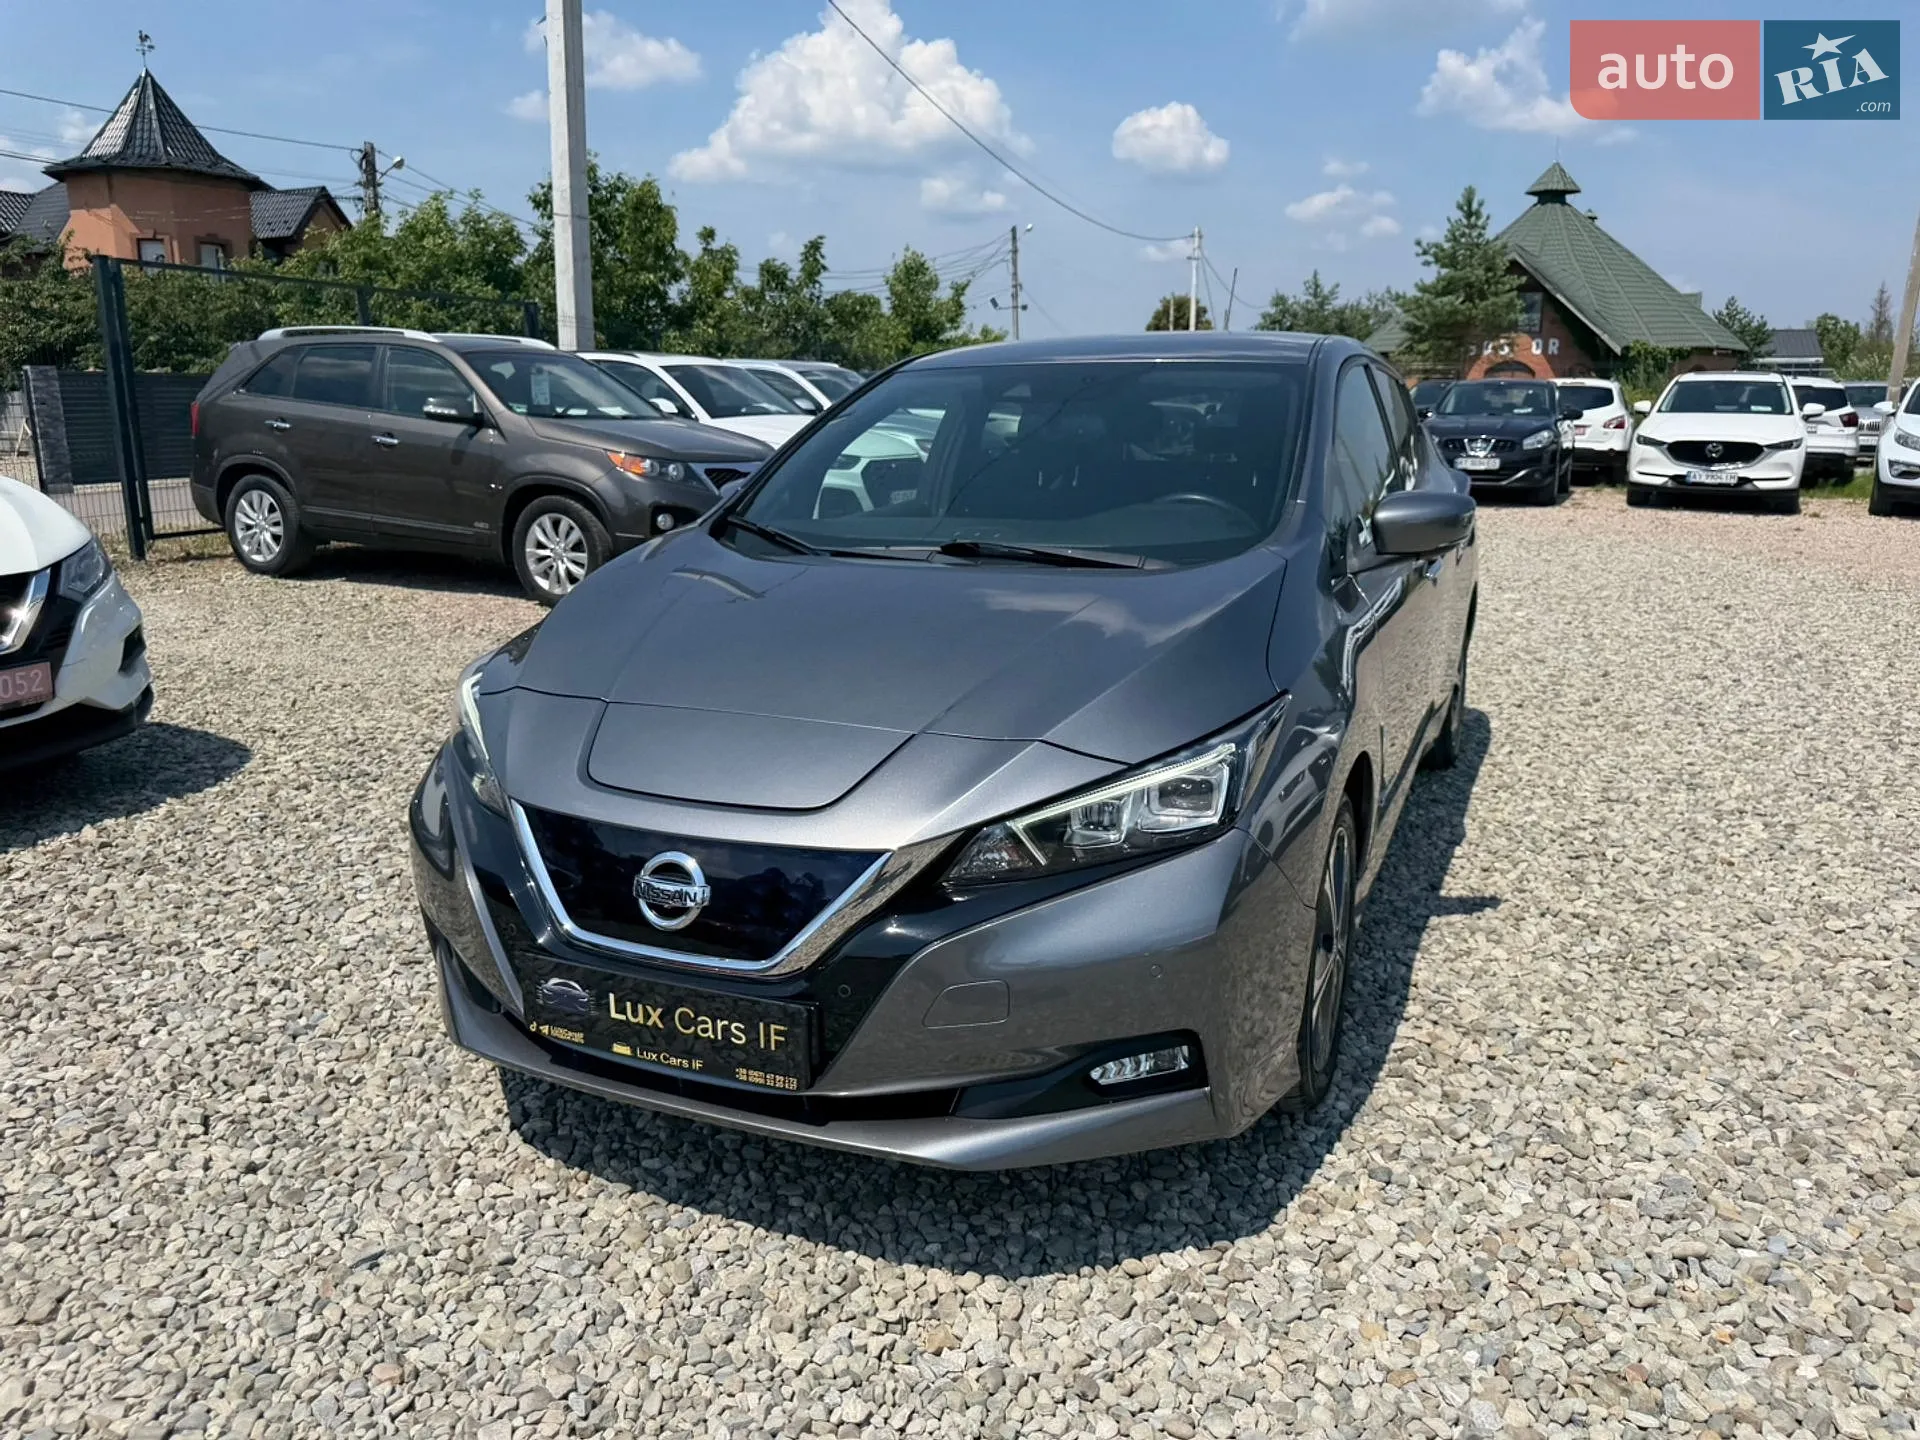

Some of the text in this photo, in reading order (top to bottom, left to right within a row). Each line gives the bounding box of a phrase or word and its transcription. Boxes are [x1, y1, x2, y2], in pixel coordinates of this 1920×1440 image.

[0, 669, 44, 699] 052
[636, 881, 698, 905] NISSAN
[609, 992, 788, 1051] Lux Cars IF
[637, 1047, 704, 1071] Lux Cars IF
